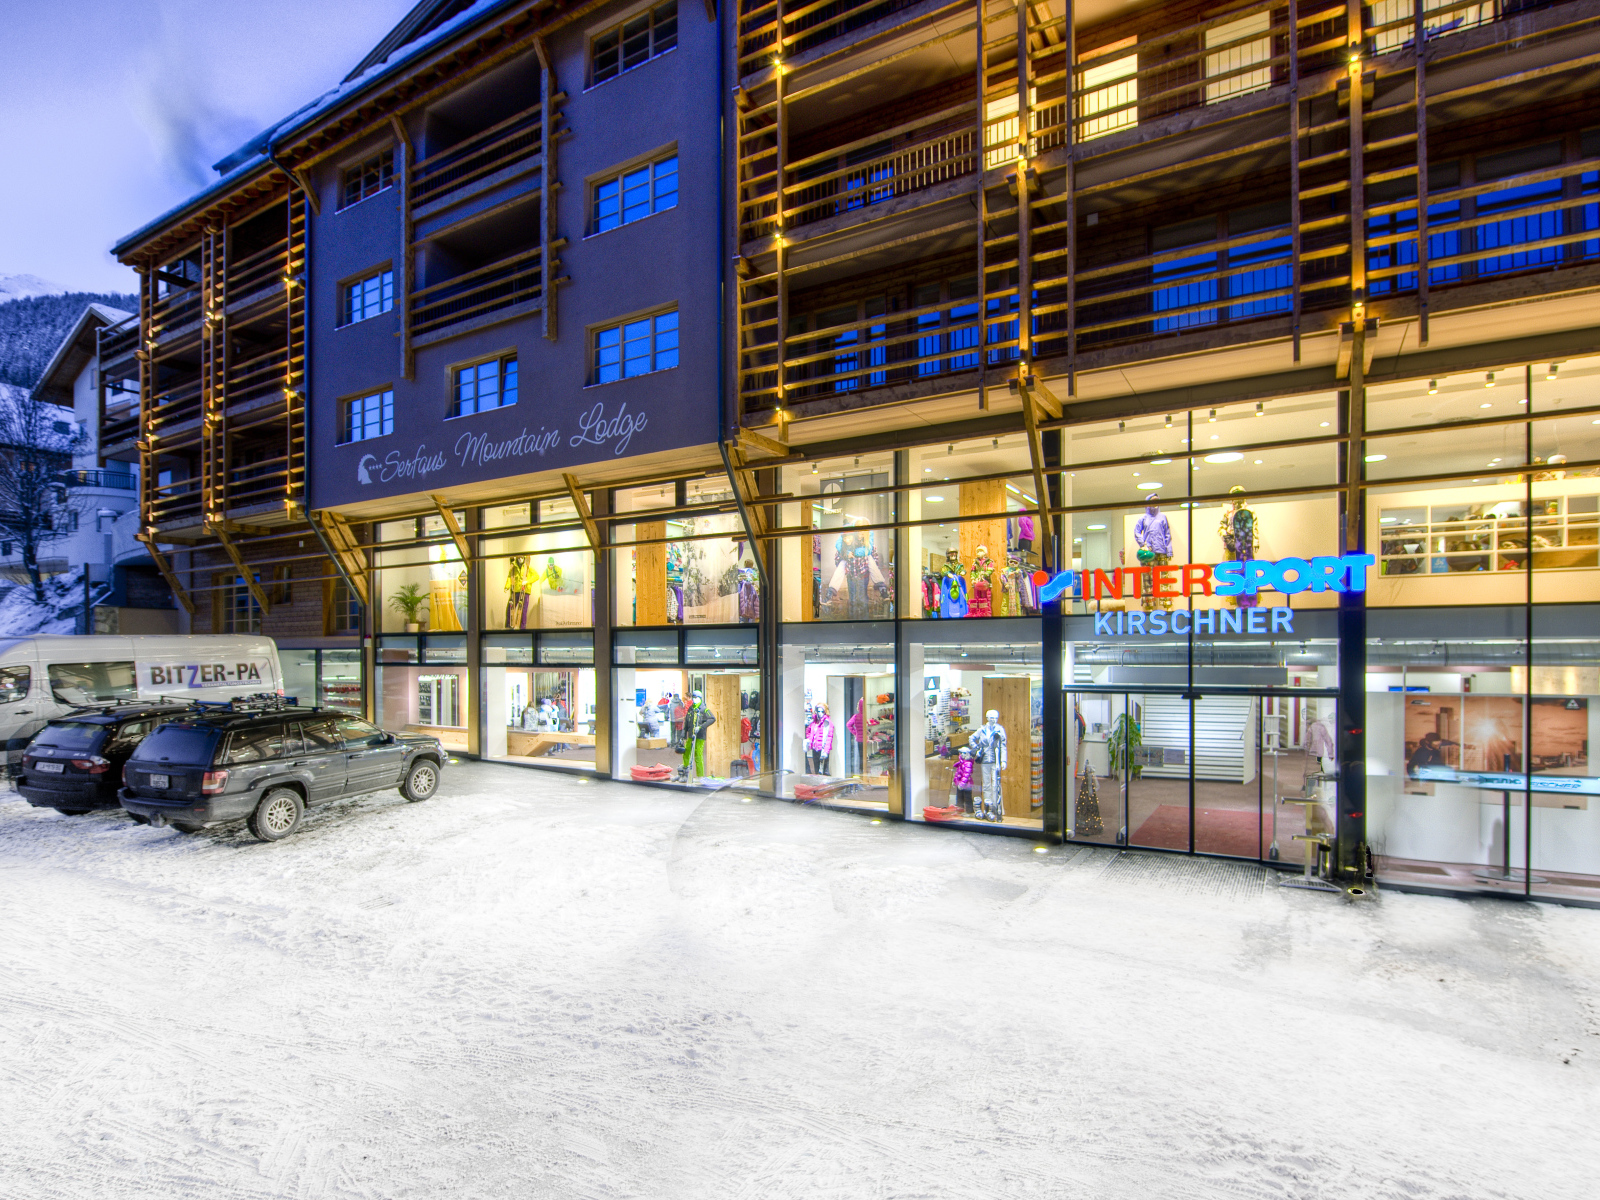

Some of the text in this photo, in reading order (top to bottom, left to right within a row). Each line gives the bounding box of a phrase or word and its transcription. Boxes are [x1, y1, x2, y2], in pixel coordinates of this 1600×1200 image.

[380, 402, 648, 482] Serfaus Mountain Lodge
[1082, 553, 1376, 601] INTERSPORT
[1093, 606, 1294, 636] KIRSCHNER
[150, 663, 261, 688] BITZER-PA
